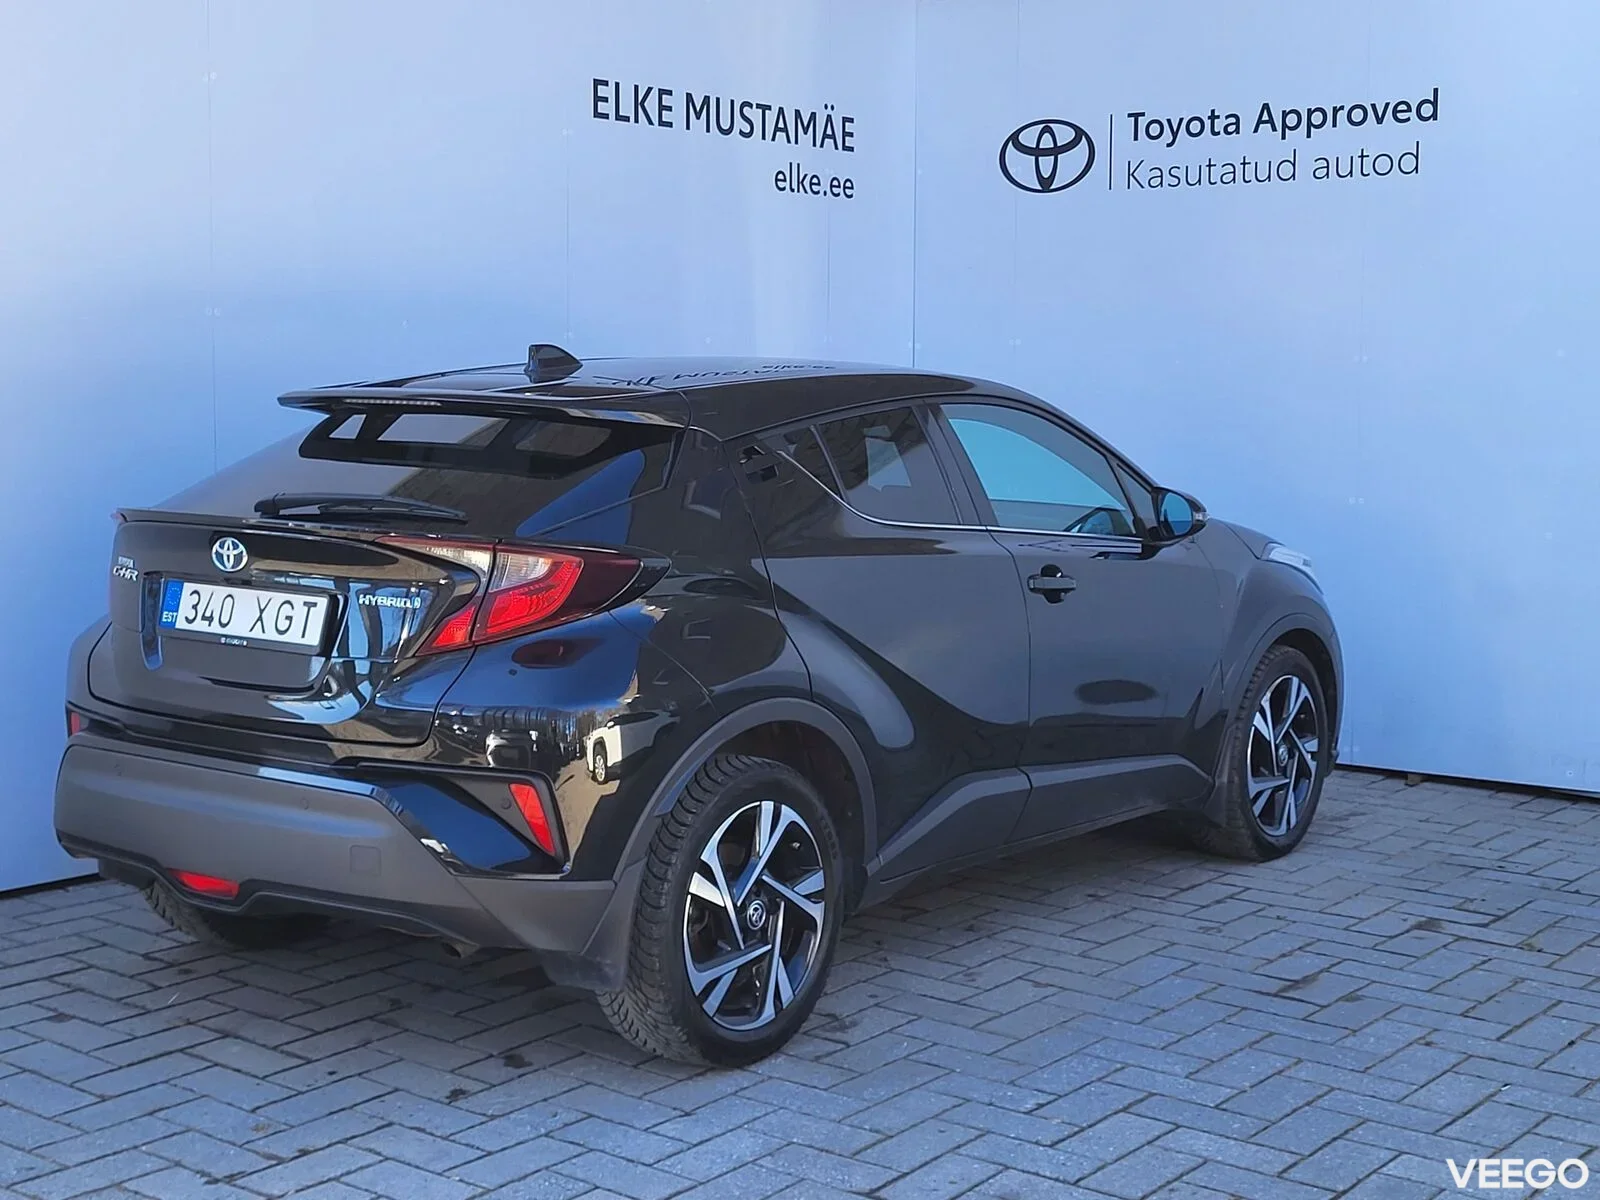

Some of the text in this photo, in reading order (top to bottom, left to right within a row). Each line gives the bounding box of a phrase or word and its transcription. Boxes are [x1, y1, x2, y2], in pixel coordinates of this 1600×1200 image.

[592, 77, 856, 153] ELKE MUSTAMÄE
[1127, 86, 1440, 148] Toyota Approved
[773, 161, 856, 199] elke.ee
[1126, 140, 1421, 190] Kasutatud autod
[162, 611, 178, 623] EST
[184, 588, 319, 639] 340 XGT
[358, 594, 413, 608] HYBRID
